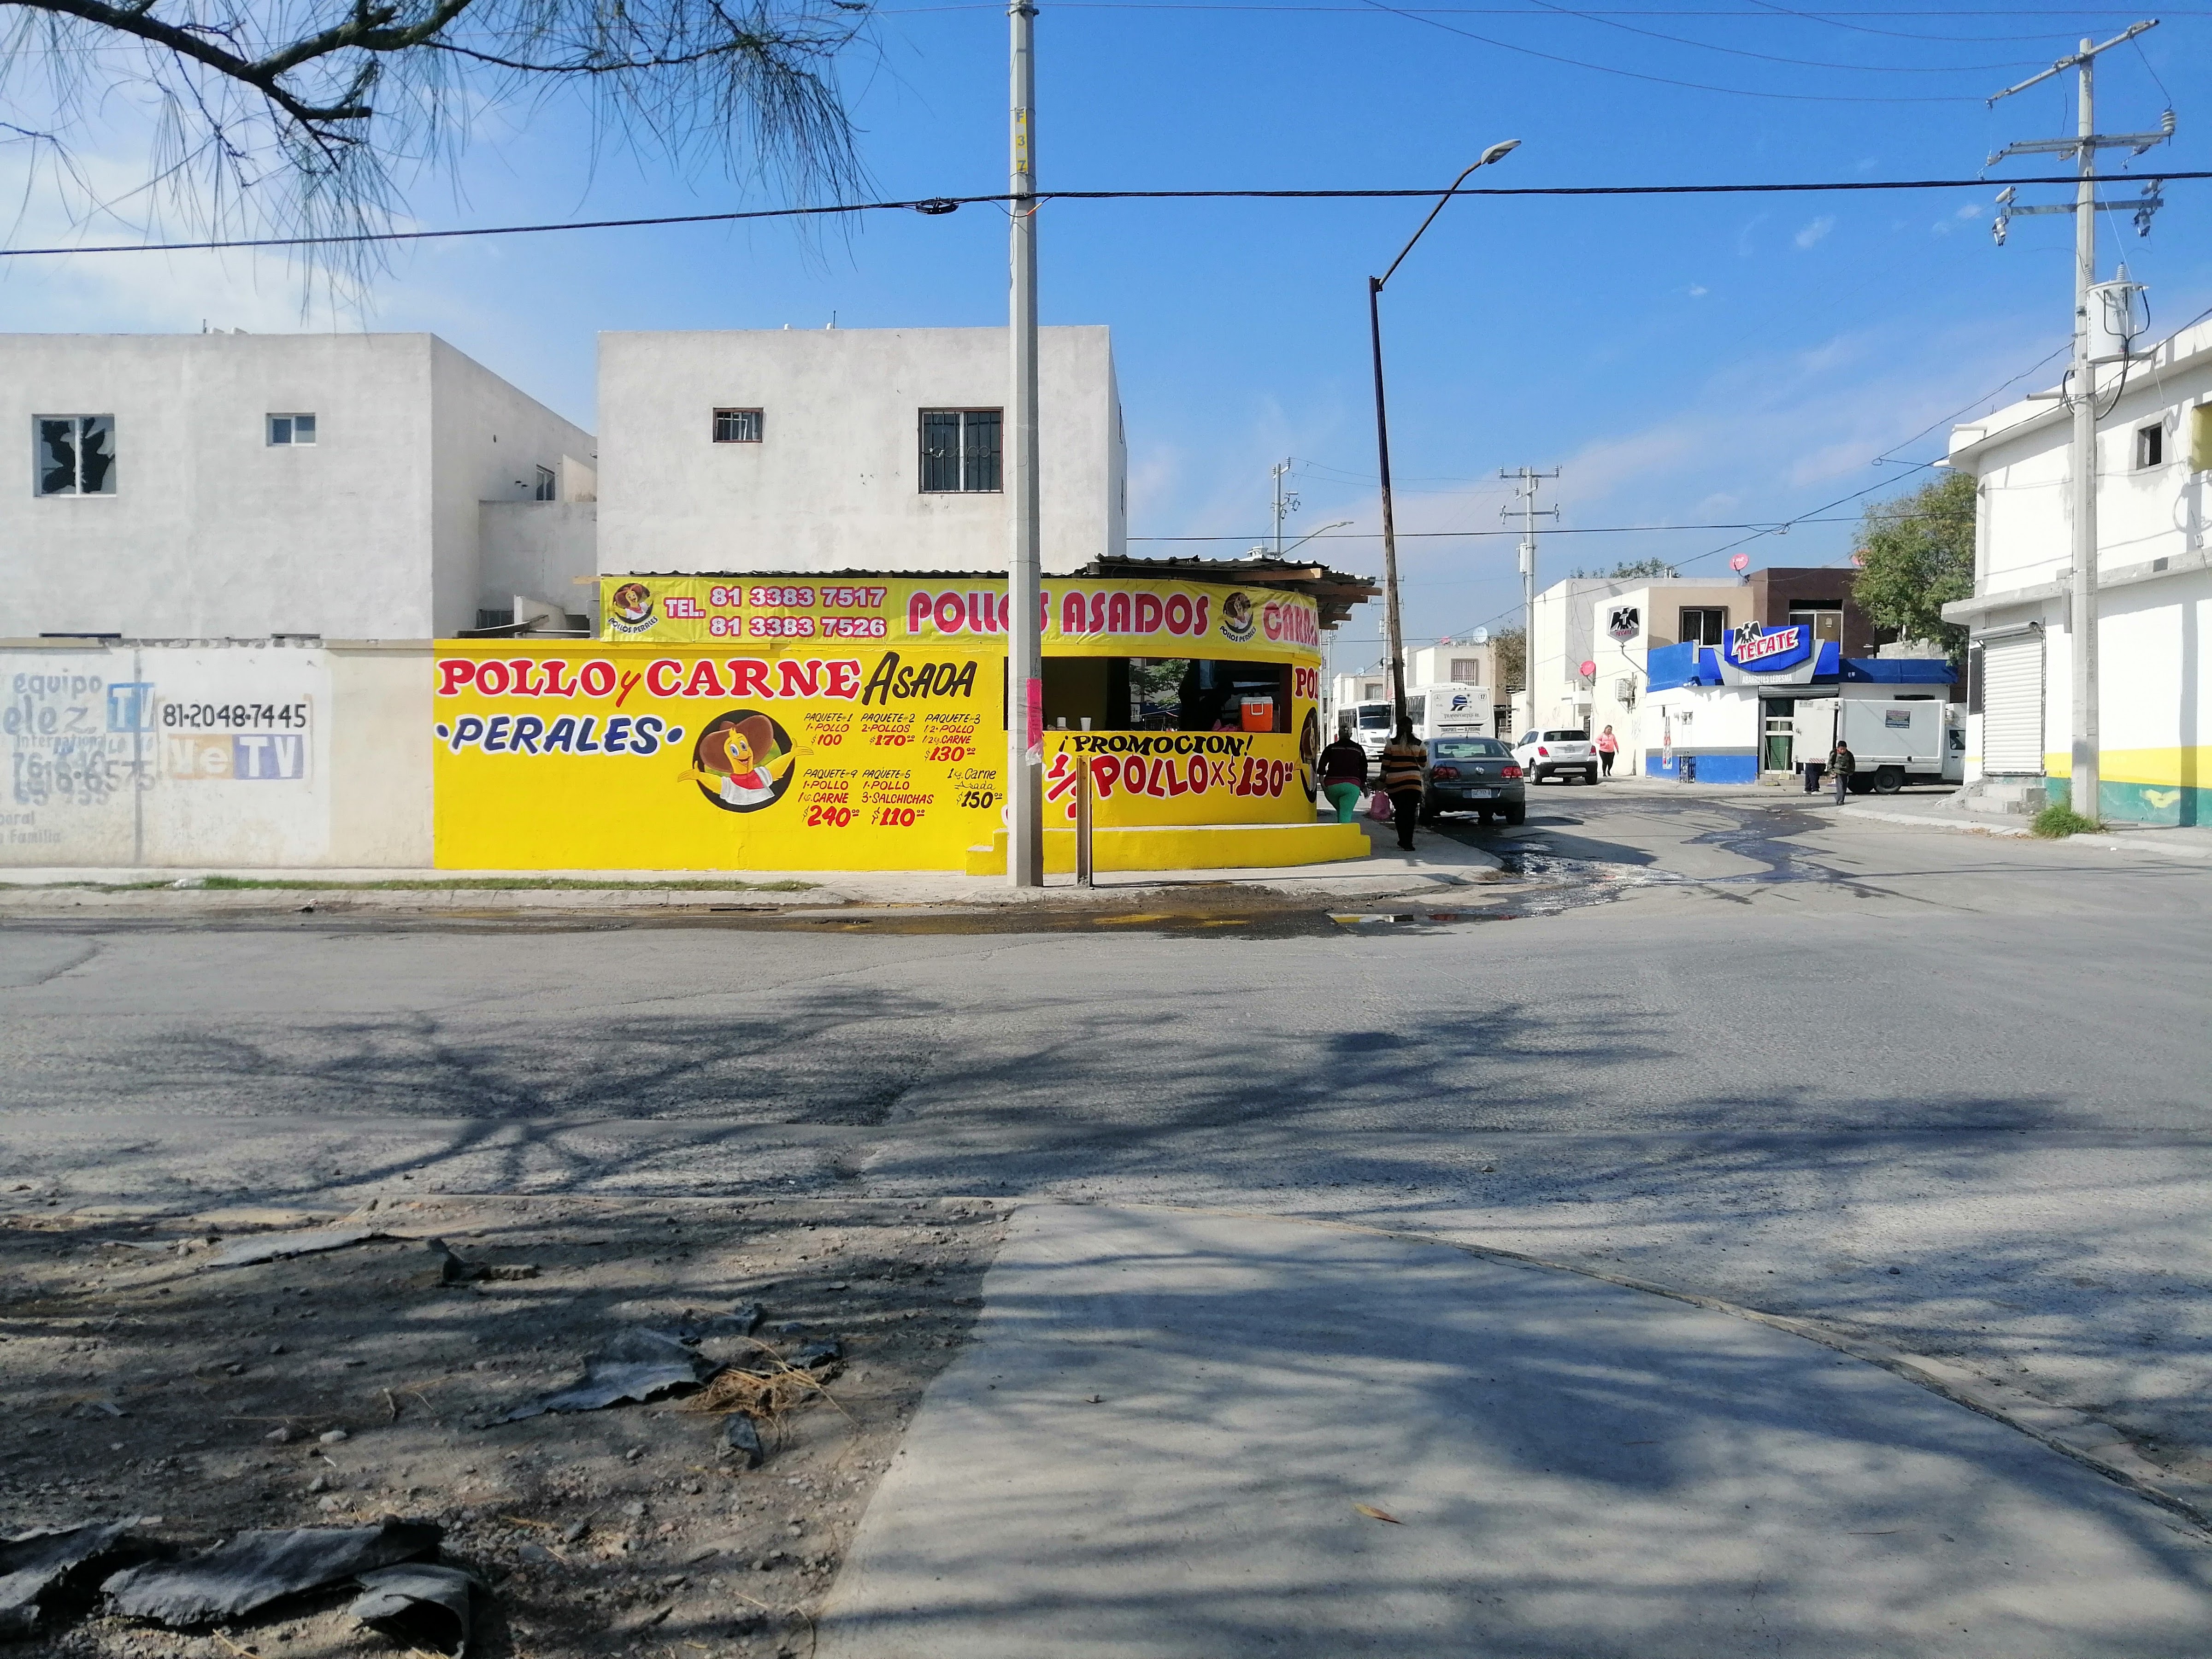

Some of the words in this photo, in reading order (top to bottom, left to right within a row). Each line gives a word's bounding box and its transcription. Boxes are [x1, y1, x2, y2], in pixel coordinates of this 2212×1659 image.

[711, 587, 741, 606] 81
[750, 587, 814, 606] 3383
[821, 588, 886, 606] 7517
[665, 599, 705, 618] TEL.
[1062, 592, 1209, 636] ASADOS
[608, 618, 631, 633] POLLOS
[633, 616, 658, 633] PERALES
[711, 617, 741, 636] 81
[750, 617, 814, 637] 3383
[821, 618, 886, 637] 7526
[1219, 626, 1238, 642] POLLOS
[1239, 626, 1257, 642] PERALES
[1736, 630, 1795, 660] TECATE
[438, 659, 617, 697] POLLO
[647, 660, 860, 699] CARNE
[1770, 674, 1792, 683] LEDESMA
[811, 734, 842, 746] $100
[1091, 754, 1209, 798] POLLO
